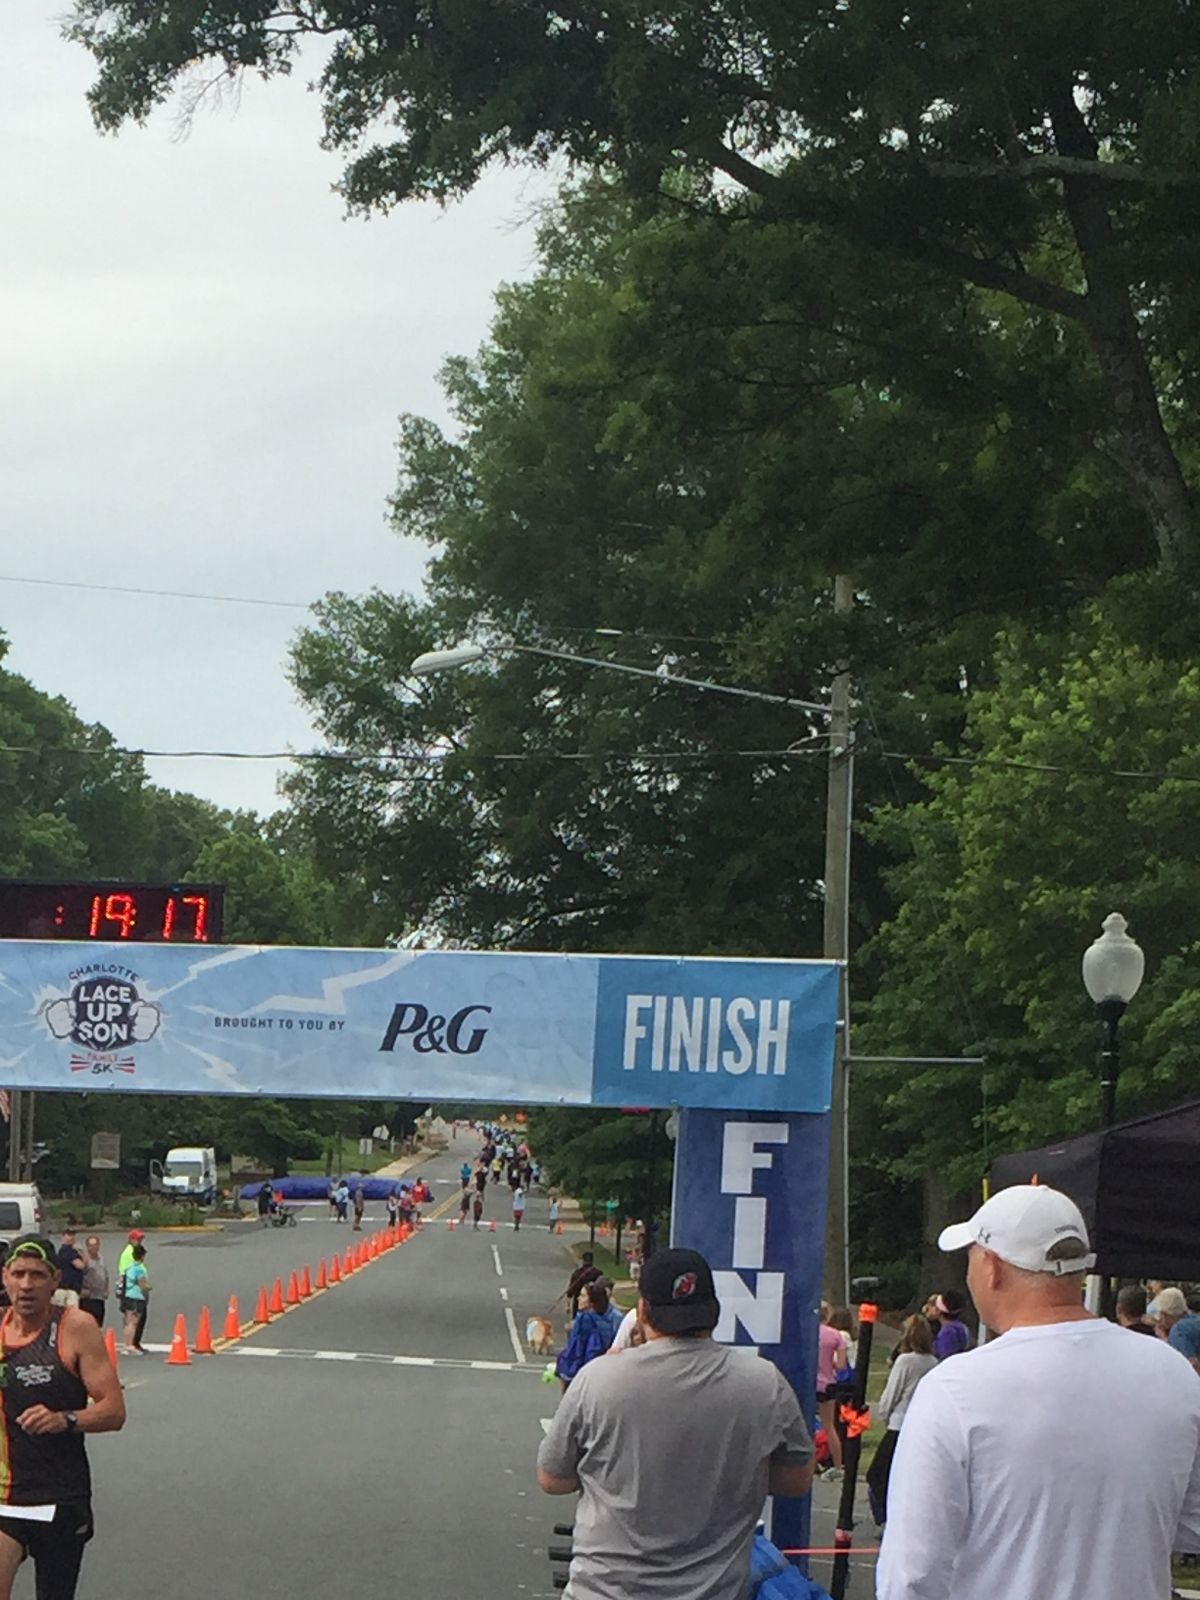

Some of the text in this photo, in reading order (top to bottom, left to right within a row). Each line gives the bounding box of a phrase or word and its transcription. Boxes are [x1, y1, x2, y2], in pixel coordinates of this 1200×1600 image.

[68, 963, 140, 982] CHARLOTTE
[79, 984, 132, 1003] LACE
[87, 1002, 123, 1022] UP
[78, 1021, 128, 1042] SON
[214, 1016, 346, 1031] BROUGHT TO YOU BY
[379, 1002, 493, 1055] P&G
[623, 993, 792, 1076] FINISH
[91, 1063, 114, 1075] 5K
[711, 1121, 790, 1353] FIN
